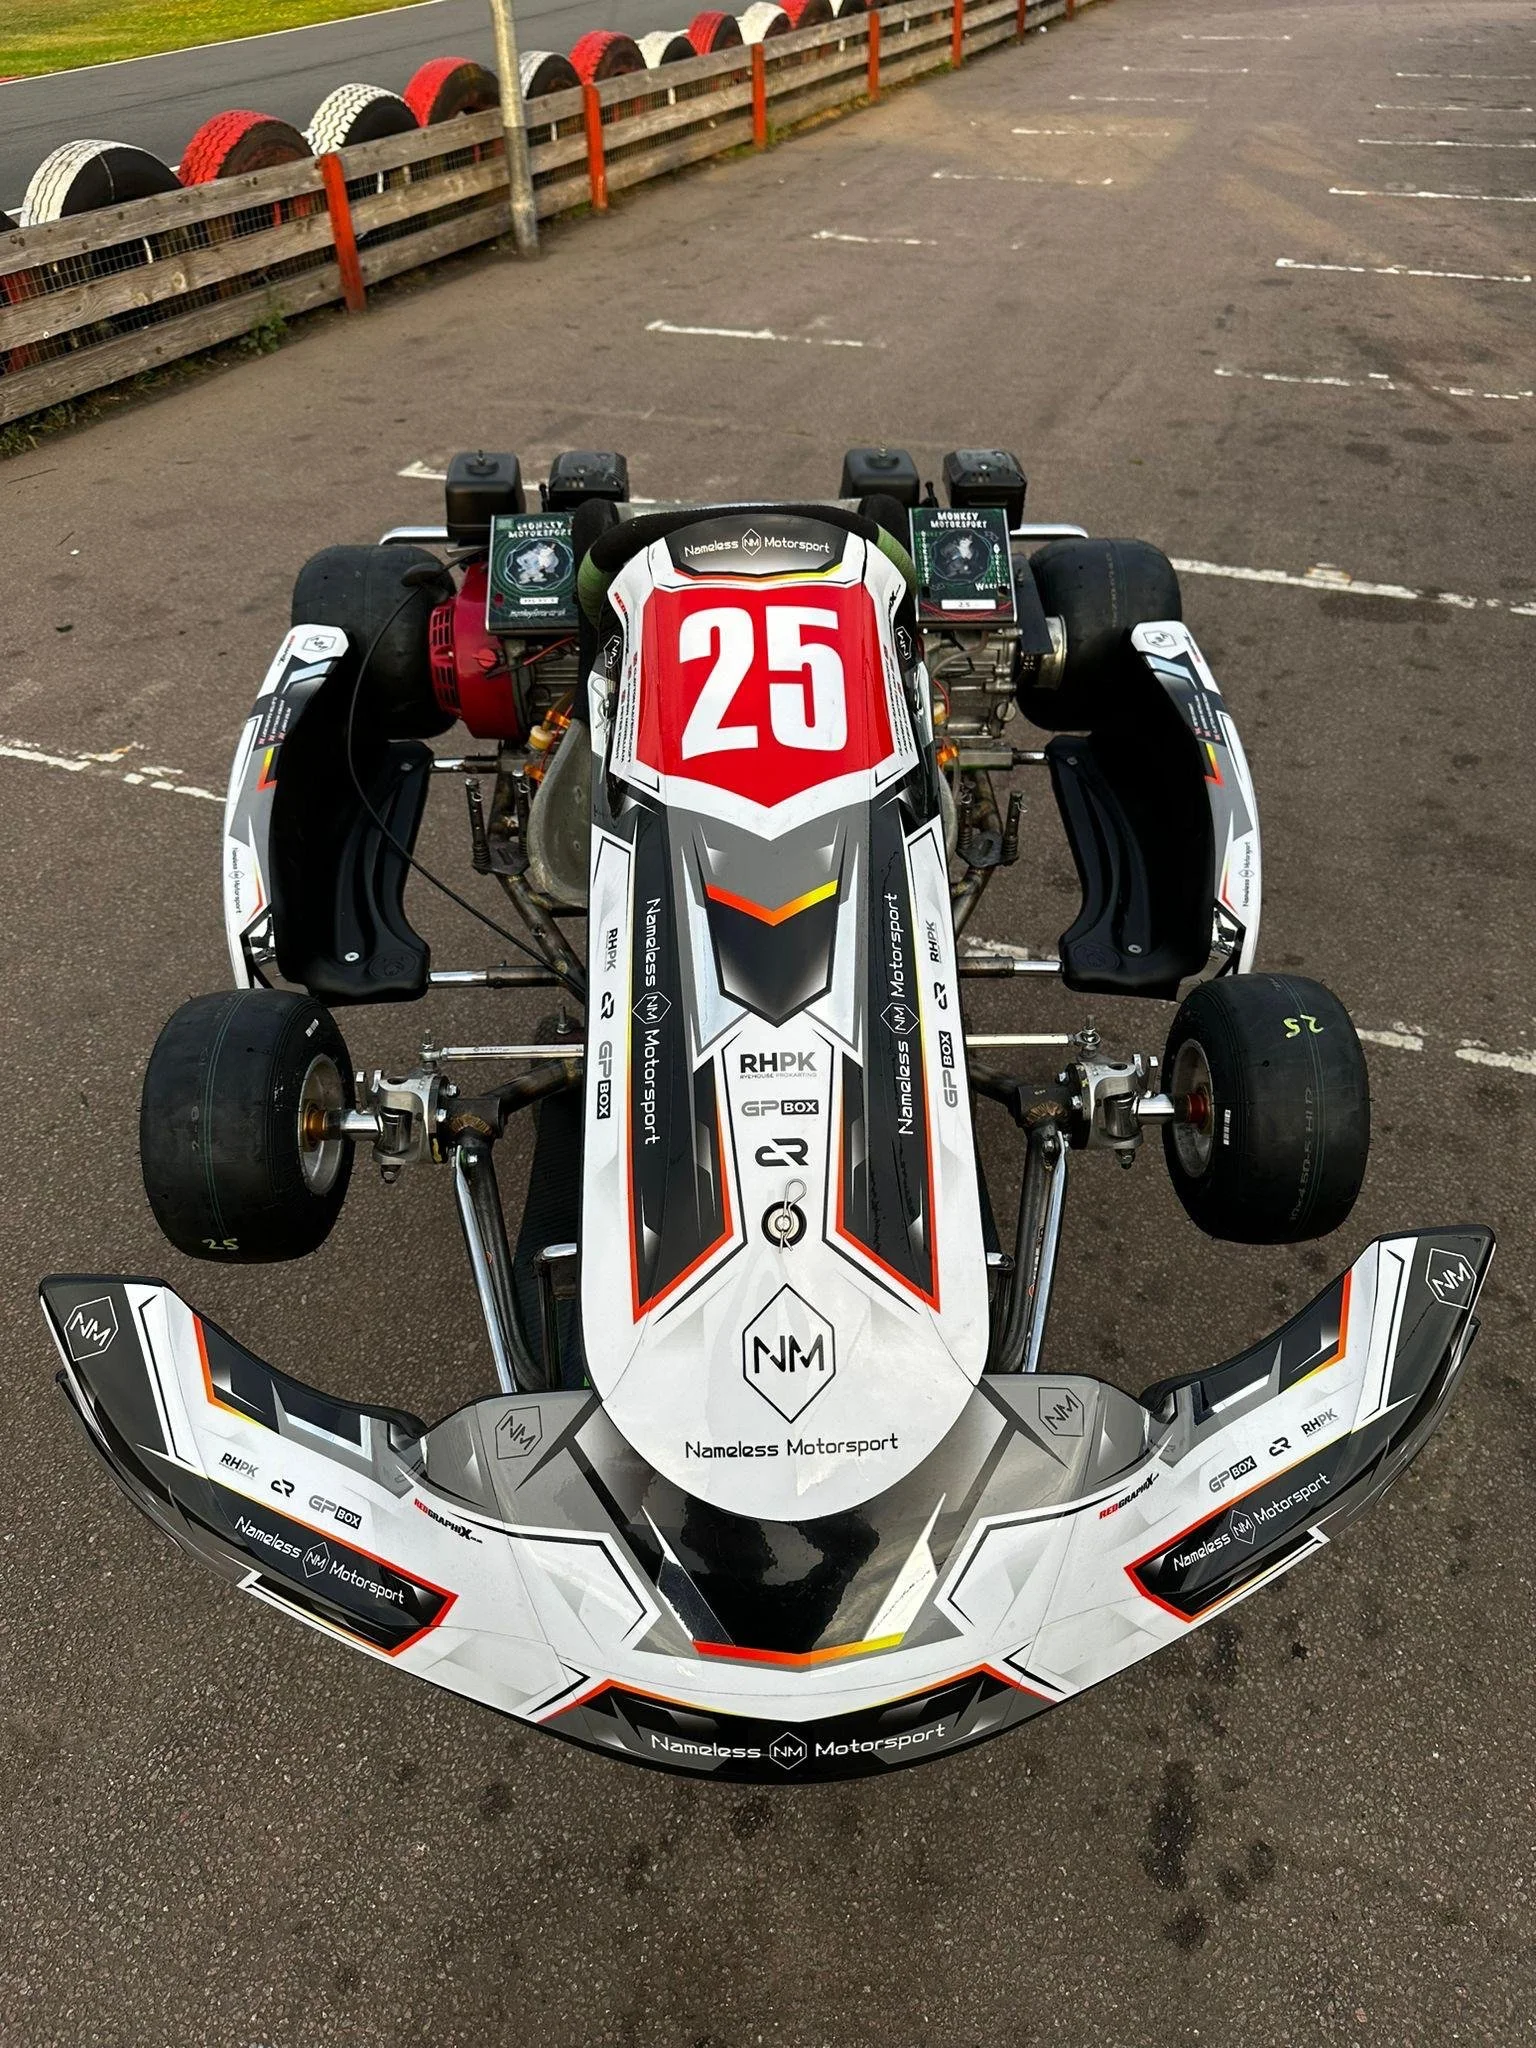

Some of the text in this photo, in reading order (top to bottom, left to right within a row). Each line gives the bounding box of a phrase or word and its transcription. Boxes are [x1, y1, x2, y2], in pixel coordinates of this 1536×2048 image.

[930, 520, 988, 529] MOTORSPORT
[937, 512, 979, 521] MONKEY
[684, 540, 739, 557] Nameless
[764, 537, 830, 554] Motorsport
[679, 605, 848, 761] 25
[607, 928, 618, 971] RHPK
[645, 898, 661, 987] Nameless
[884, 893, 905, 998] Motorsport
[925, 920, 939, 963] RHPK
[740, 1051, 817, 1073] RHPK
[640, 1029, 660, 1144] Motorsport
[895, 1040, 914, 1135] Nameless
[201, 1238, 240, 1251] 25
[1431, 1262, 1472, 1297] NM
[70, 1311, 111, 1347] NM
[754, 1334, 825, 1373] NM
[1044, 1394, 1079, 1430] NM
[1300, 1408, 1338, 1435] RHPK
[500, 1415, 536, 1450] NM
[685, 1433, 898, 1459] Nameless Motorsport
[220, 1452, 259, 1477] RHPK
[1173, 1532, 1231, 1572] Nameless
[1253, 1472, 1331, 1525] Motorsport
[234, 1515, 302, 1559] Nameless
[329, 1560, 405, 1604] Motorsport
[651, 1723, 946, 1758] Nameless NM Motorsport
